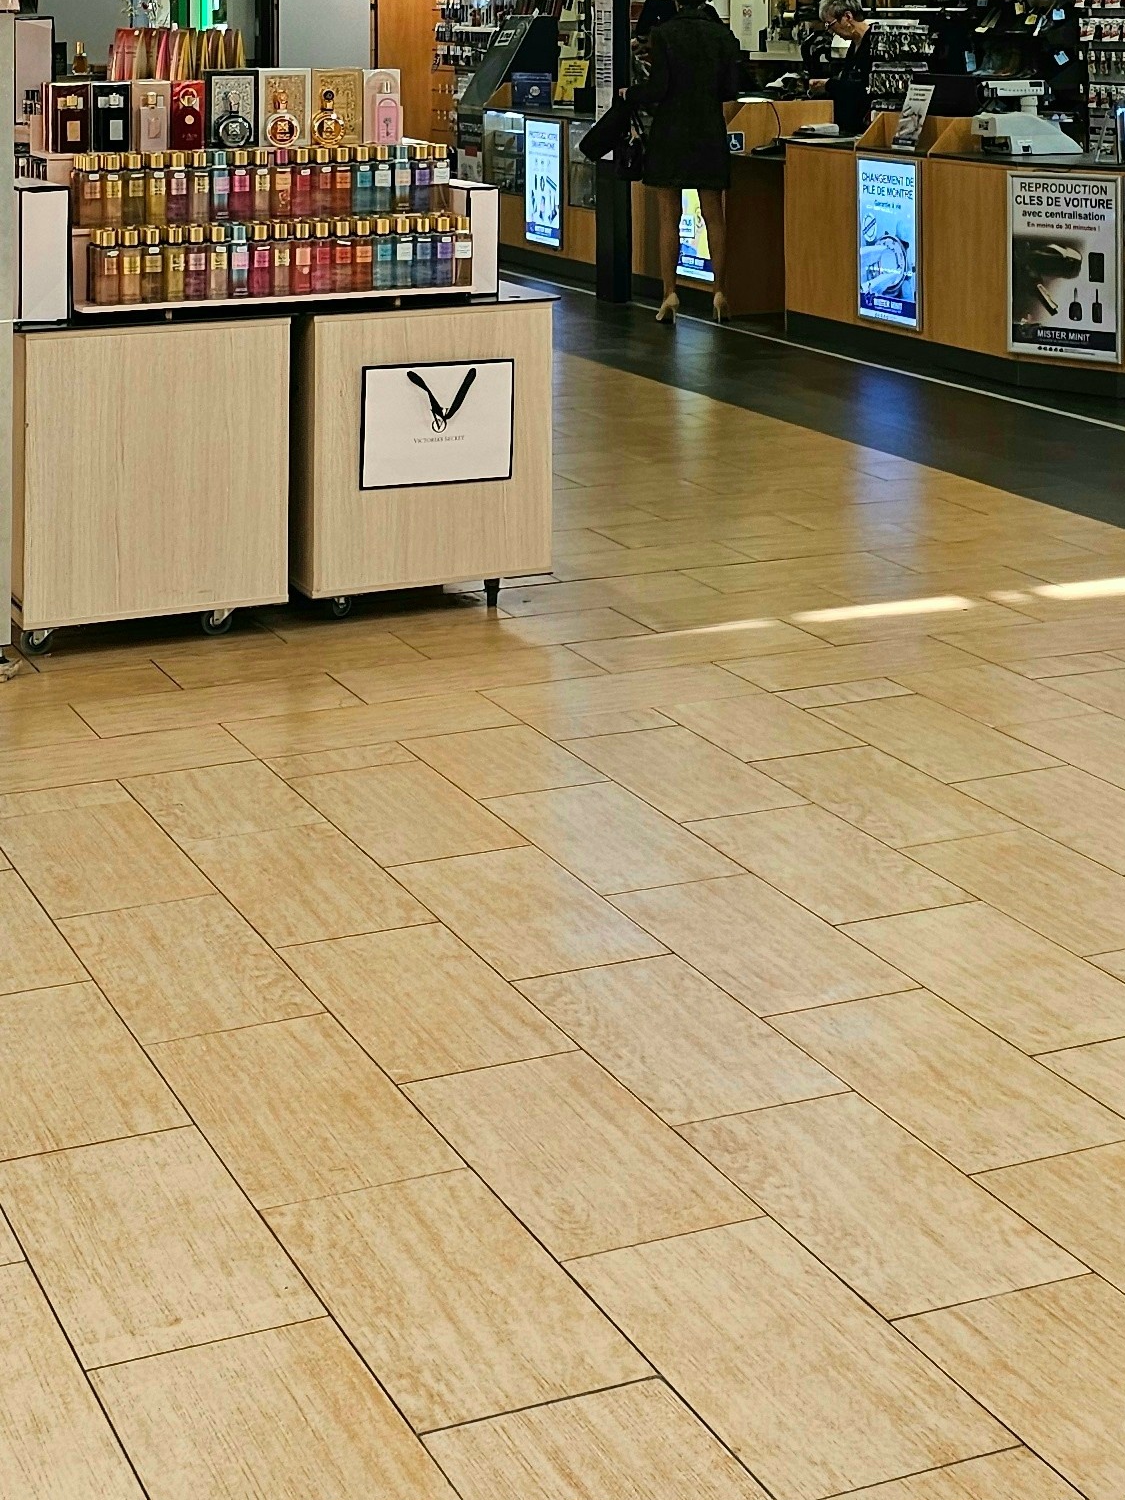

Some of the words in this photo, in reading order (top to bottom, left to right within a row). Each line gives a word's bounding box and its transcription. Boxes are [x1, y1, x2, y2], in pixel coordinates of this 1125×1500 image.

[861, 172, 904, 186] CHANGEMENT
[905, 176, 914, 187] DE
[863, 184, 876, 194] PILE
[877, 185, 886, 196] DE
[1019, 182, 1108, 195] REPRODUCTION
[1014, 194, 1044, 206] CLES
[1046, 196, 1062, 207] DE
[1063, 197, 1113, 209] VOITURE
[1044, 211, 1106, 221] centralisation
[1037, 329, 1067, 340] MISTER
[1068, 332, 1090, 342] MINIT
